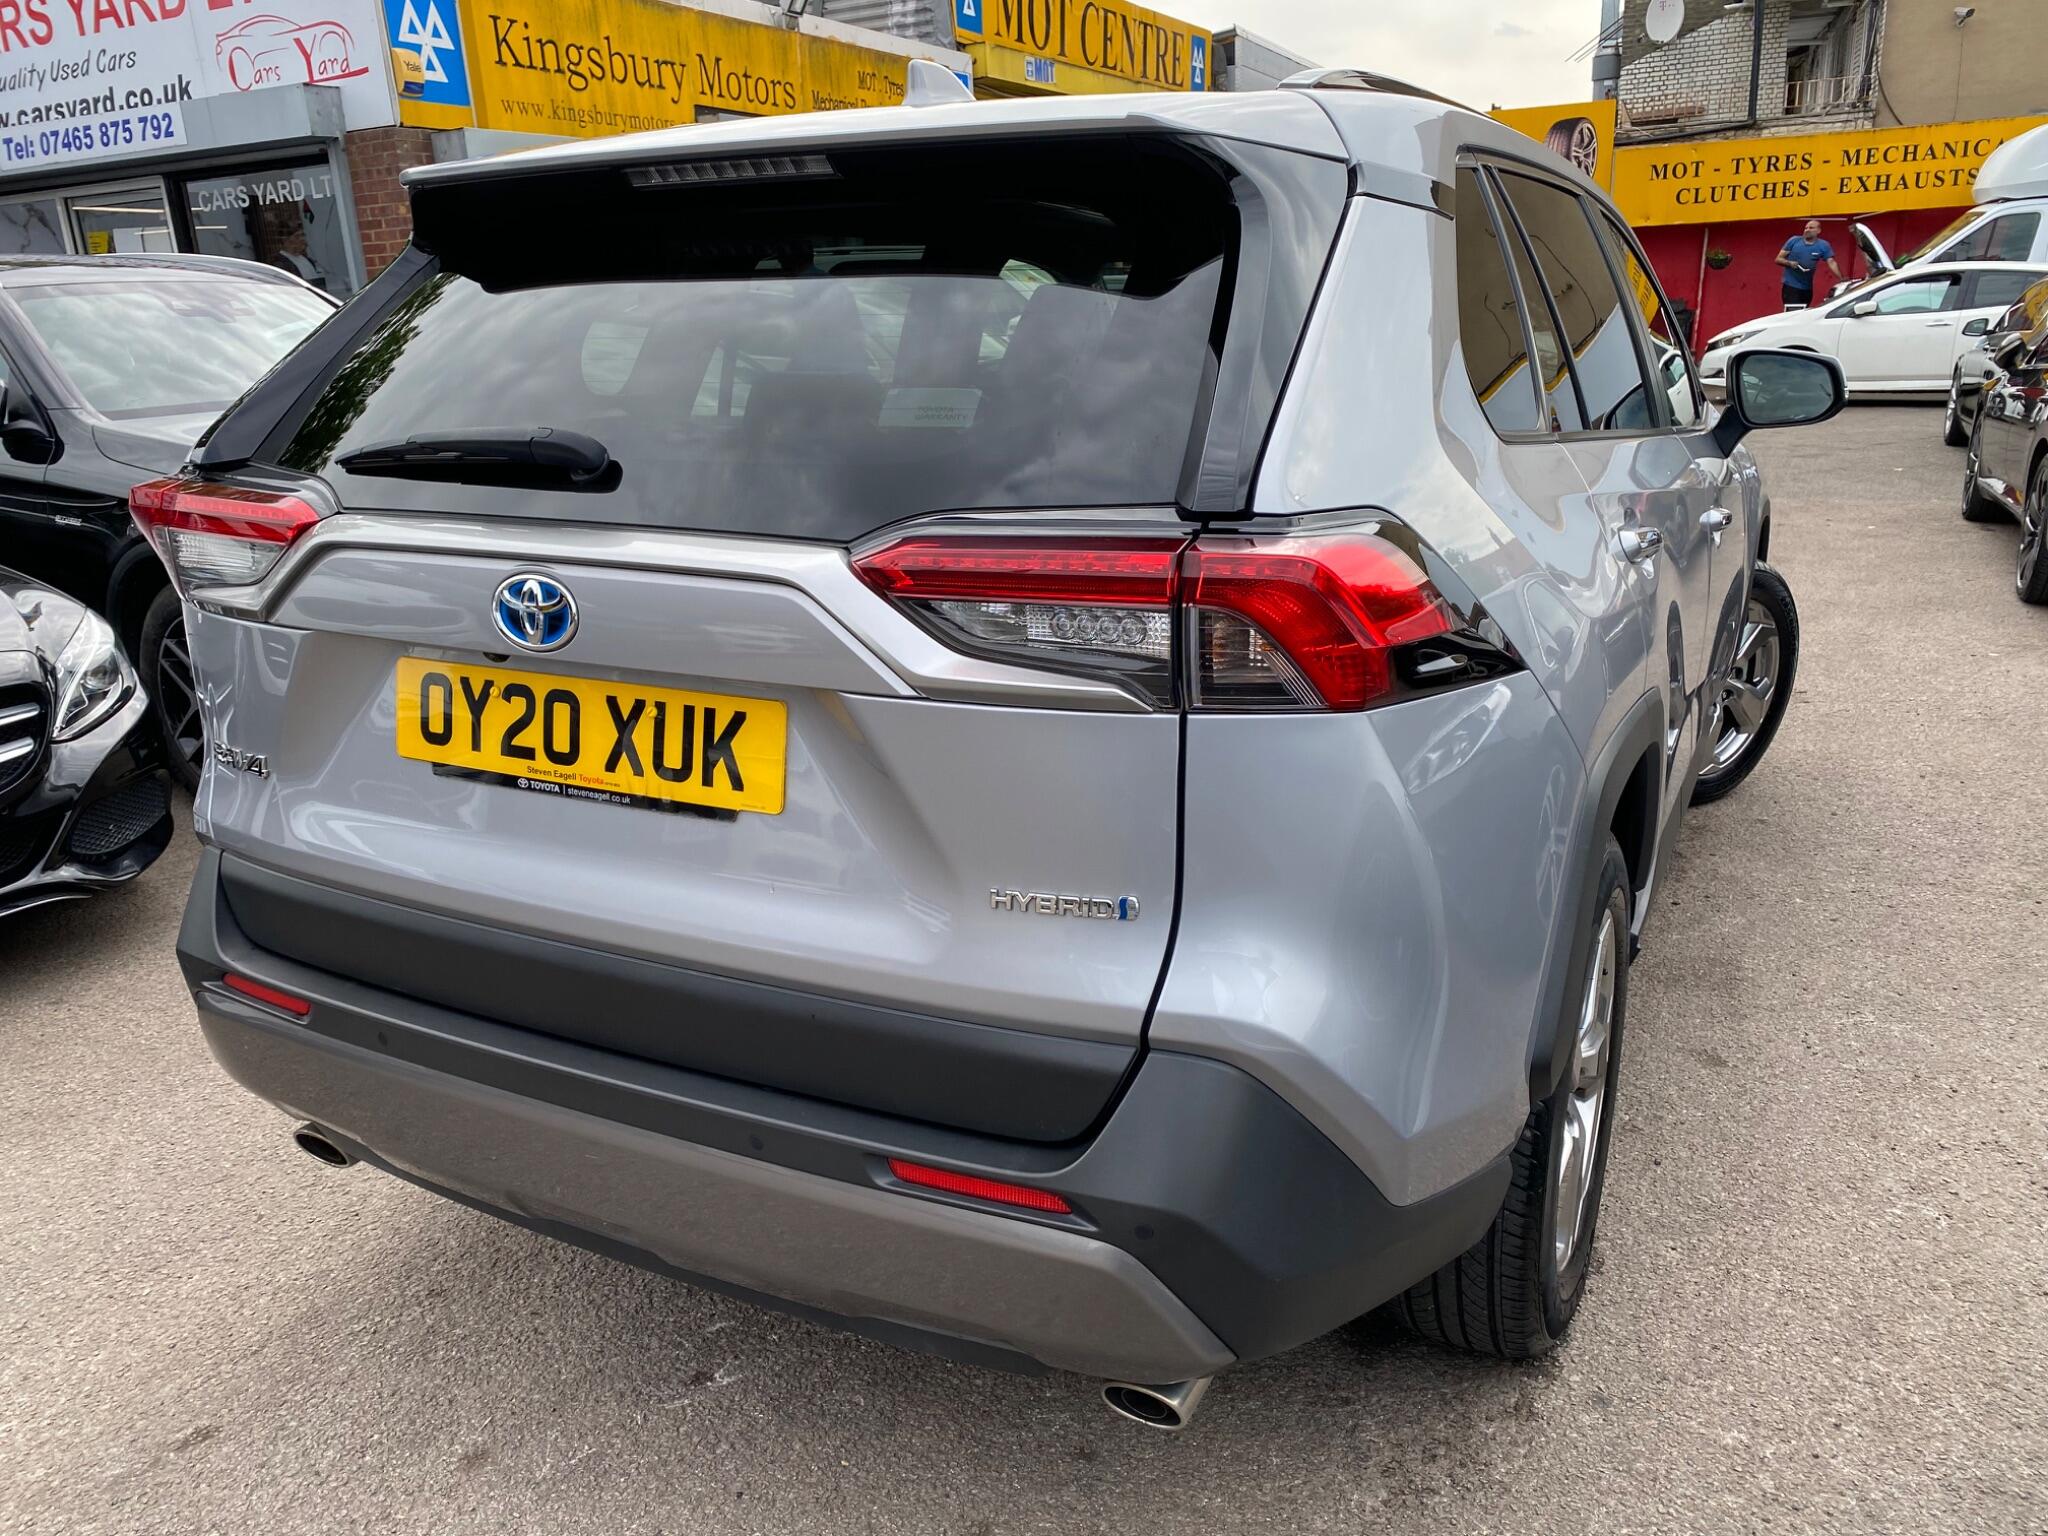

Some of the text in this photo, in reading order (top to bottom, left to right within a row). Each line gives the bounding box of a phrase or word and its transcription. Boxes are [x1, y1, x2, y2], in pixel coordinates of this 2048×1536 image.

[0, 0, 54, 52] RS
[994, 0, 1185, 88] MOT CENTRE
[50, 50, 90, 82] Used
[95, 48, 137, 73] Cars
[228, 33, 369, 92] Cars Yard
[402, 59, 422, 73] Yale
[488, 14, 797, 109] Kingsbury Motors
[857, 70, 878, 92] MOT
[883, 75, 905, 100] Tyres
[2, 112, 175, 161] Tel: 07465 875 792
[1648, 160, 1705, 181] MOT
[1731, 151, 1813, 175] TYRES
[198, 185, 251, 212] CARS
[252, 179, 305, 206] YARD
[1675, 179, 1810, 205] CLUTCHES
[1837, 167, 1980, 194] EXHAUSTS
[419, 671, 749, 793] OY20 XUK
[526, 765, 553, 777] Steven
[553, 770, 577, 782] Eagell
[578, 773, 605, 785] Toyota
[529, 782, 561, 794] TOYOTA
[989, 888, 1115, 921] HYBRID
